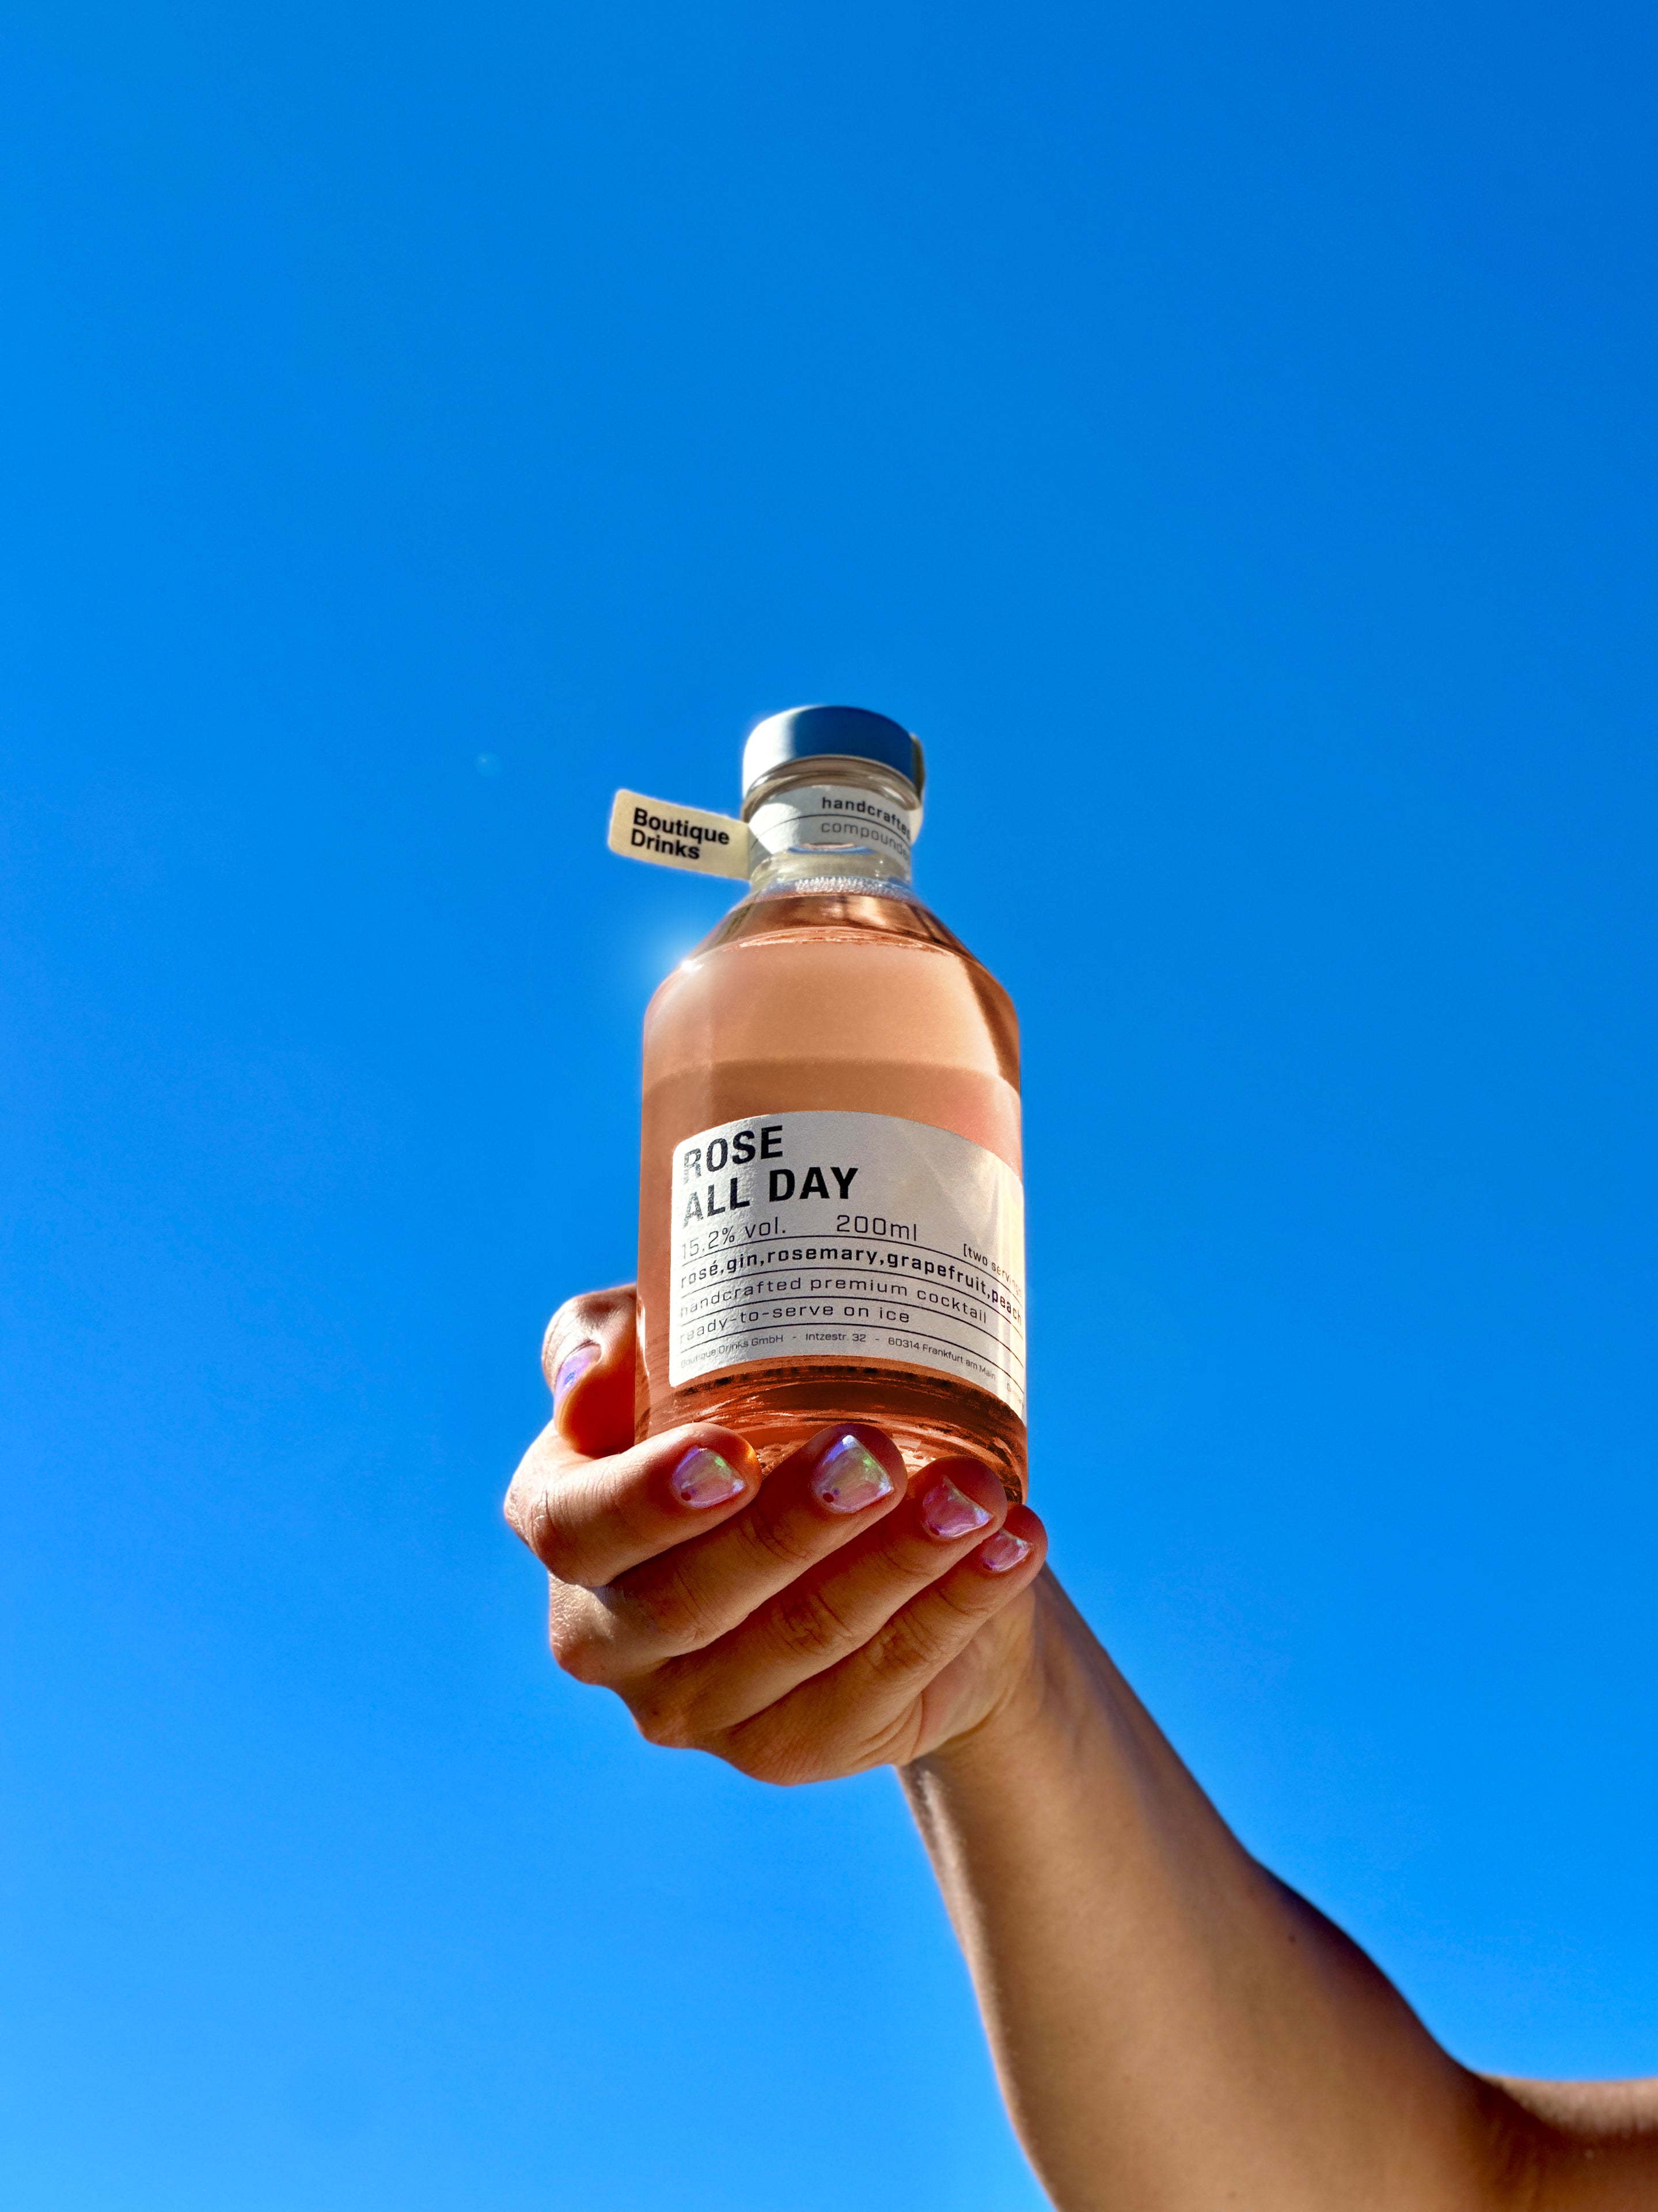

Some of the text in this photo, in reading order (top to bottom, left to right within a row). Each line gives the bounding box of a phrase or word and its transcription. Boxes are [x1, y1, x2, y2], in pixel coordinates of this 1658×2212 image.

[631, 828, 700, 859] Drinks
[633, 807, 730, 845] Boutique
[683, 1125, 783, 1185] ROSE
[682, 1166, 859, 1229] ALL DAY
[681, 1225, 735, 1260] 15.2%
[745, 1217, 786, 1238] vol.
[836, 1214, 917, 1241] 200ml
[963, 1243, 988, 1266] [two
[680, 1277, 987, 1324] handcrafted premium cocktail
[680, 1305, 909, 1343] ready-to-serve on ice
[719, 1340, 749, 1354] Drinks
[752, 1334, 783, 1347] GmbH
[852, 1334, 866, 1342] 32
[888, 1337, 920, 1350] 60314
[923, 1343, 964, 1364] Frankfurt
[966, 1359, 978, 1370] am
[979, 1364, 996, 1381] Main
